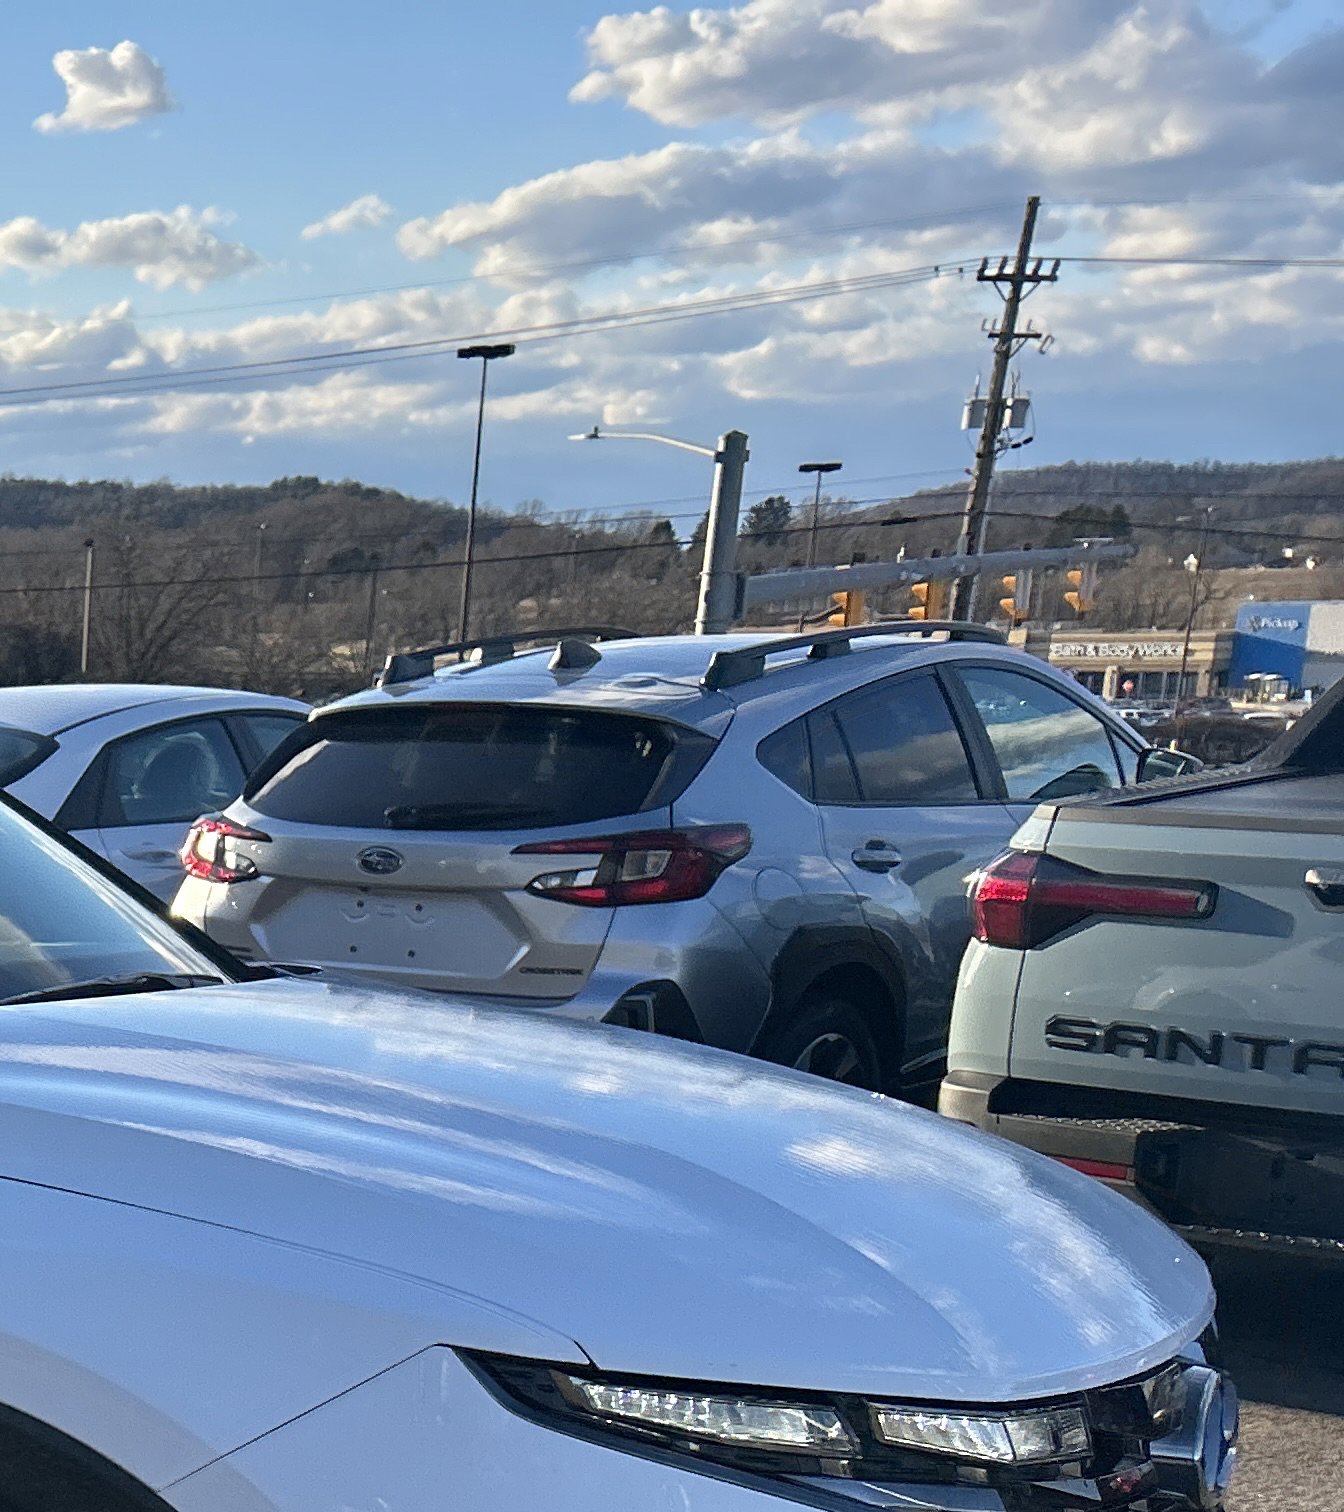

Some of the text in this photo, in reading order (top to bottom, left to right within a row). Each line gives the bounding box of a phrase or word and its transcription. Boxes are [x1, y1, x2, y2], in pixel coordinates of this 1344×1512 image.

[1261, 616, 1299, 631] Pickup
[1052, 642, 1084, 656] Bath
[1099, 642, 1136, 658] Body
